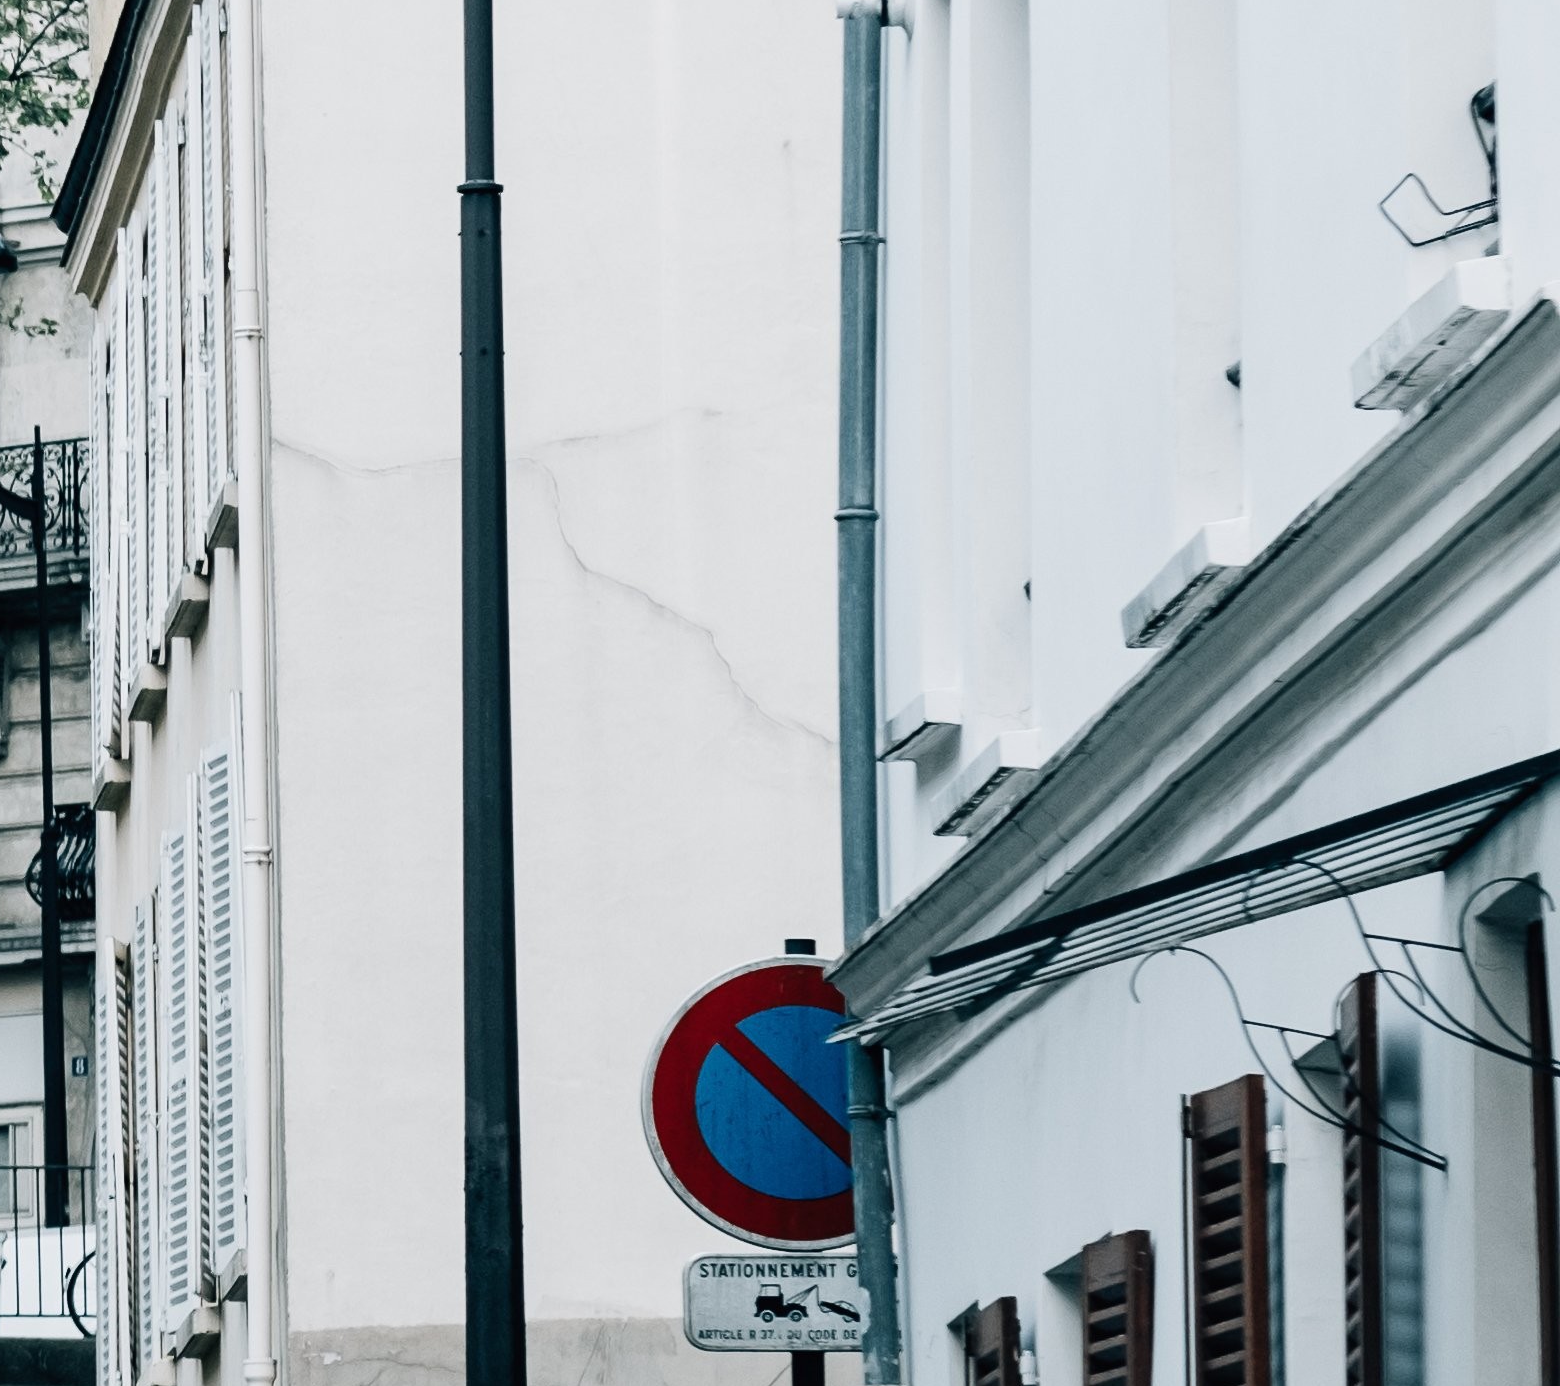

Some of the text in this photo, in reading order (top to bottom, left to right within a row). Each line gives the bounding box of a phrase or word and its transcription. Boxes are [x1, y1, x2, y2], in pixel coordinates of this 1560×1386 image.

[699, 1263, 837, 1278] STATIONNEMENT
[698, 1328, 743, 1340] ARTICLE
[808, 1328, 837, 1341] CODE
[843, 1328, 858, 1340] DE
